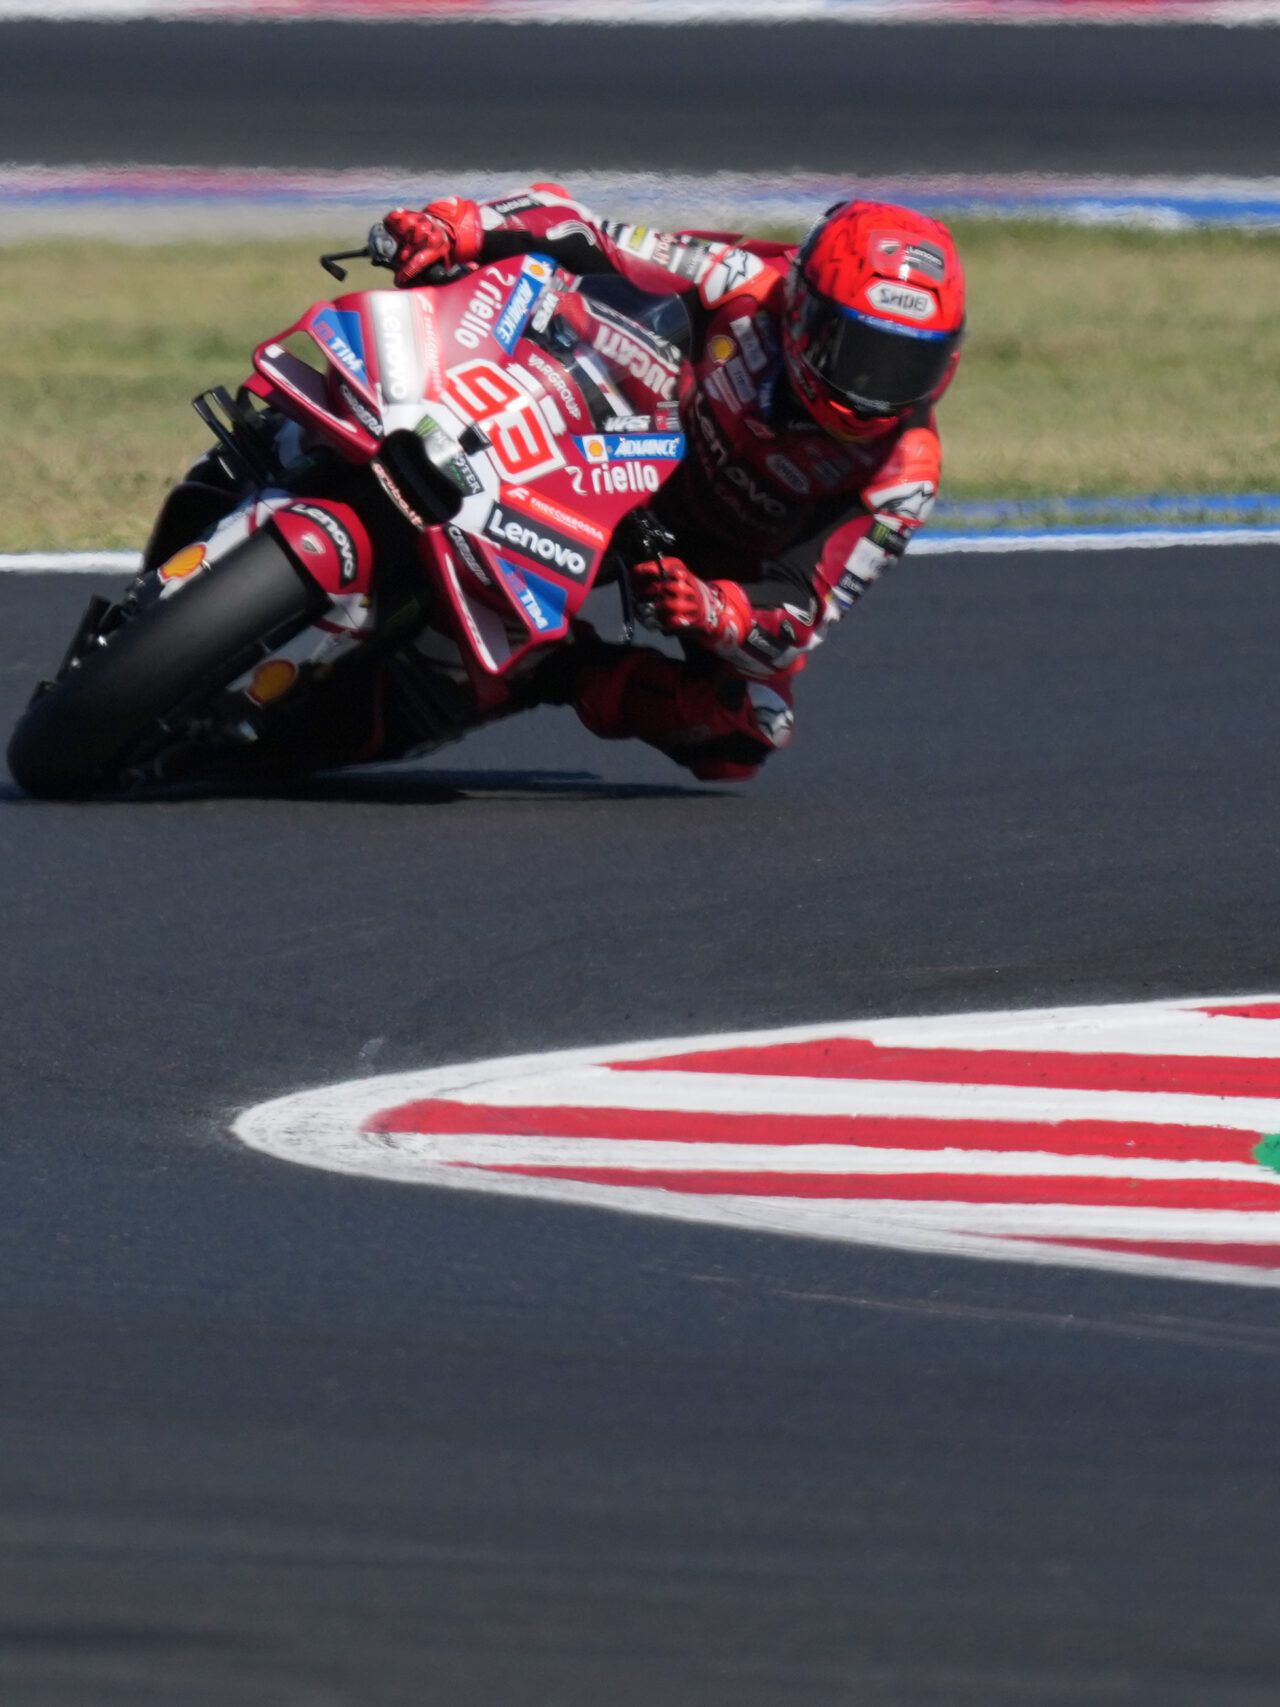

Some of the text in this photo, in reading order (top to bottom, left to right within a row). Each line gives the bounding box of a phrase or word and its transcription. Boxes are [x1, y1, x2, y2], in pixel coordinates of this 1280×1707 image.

[454, 280, 503, 349] riello
[497, 279, 534, 344] ADVANCE
[329, 337, 364, 371] TIM
[528, 353, 581, 420] VARGROUP
[444, 362, 560, 478] 93
[614, 438, 679, 457] ADVANCE
[591, 462, 659, 494] riello
[291, 504, 353, 578] Lenovo
[489, 509, 587, 574] Lenovo
[530, 497, 604, 543] FRECCIAROSSA
[519, 588, 548, 630] TIM
